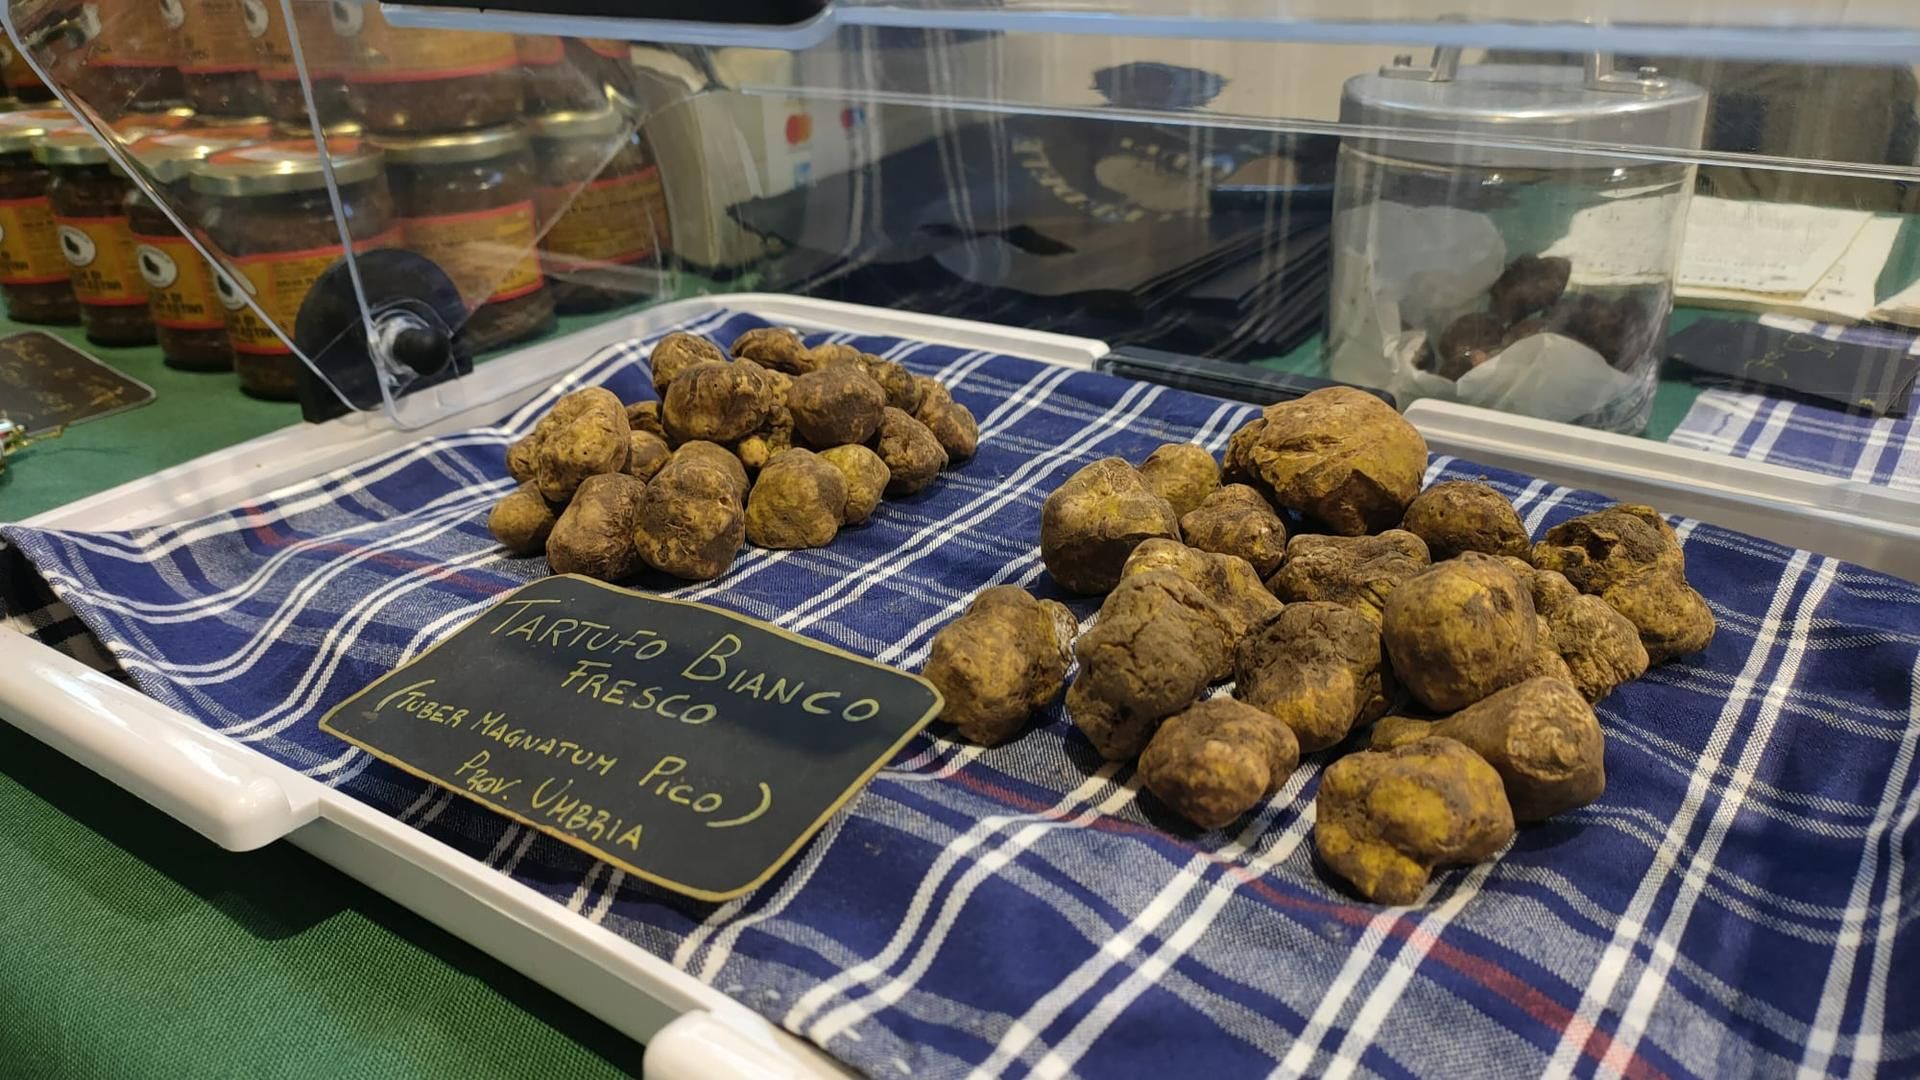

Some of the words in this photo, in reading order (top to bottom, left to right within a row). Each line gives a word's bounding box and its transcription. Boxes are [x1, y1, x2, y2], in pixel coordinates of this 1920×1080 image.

[490, 598, 669, 661] TARTUFO
[681, 632, 880, 723] BIANCO
[561, 659, 719, 725] FRESCO
[375, 678, 470, 728] (TUBER
[470, 710, 618, 776] MAGNATUM
[454, 749, 522, 801] PROV.
[531, 777, 643, 851] UMBRIA
